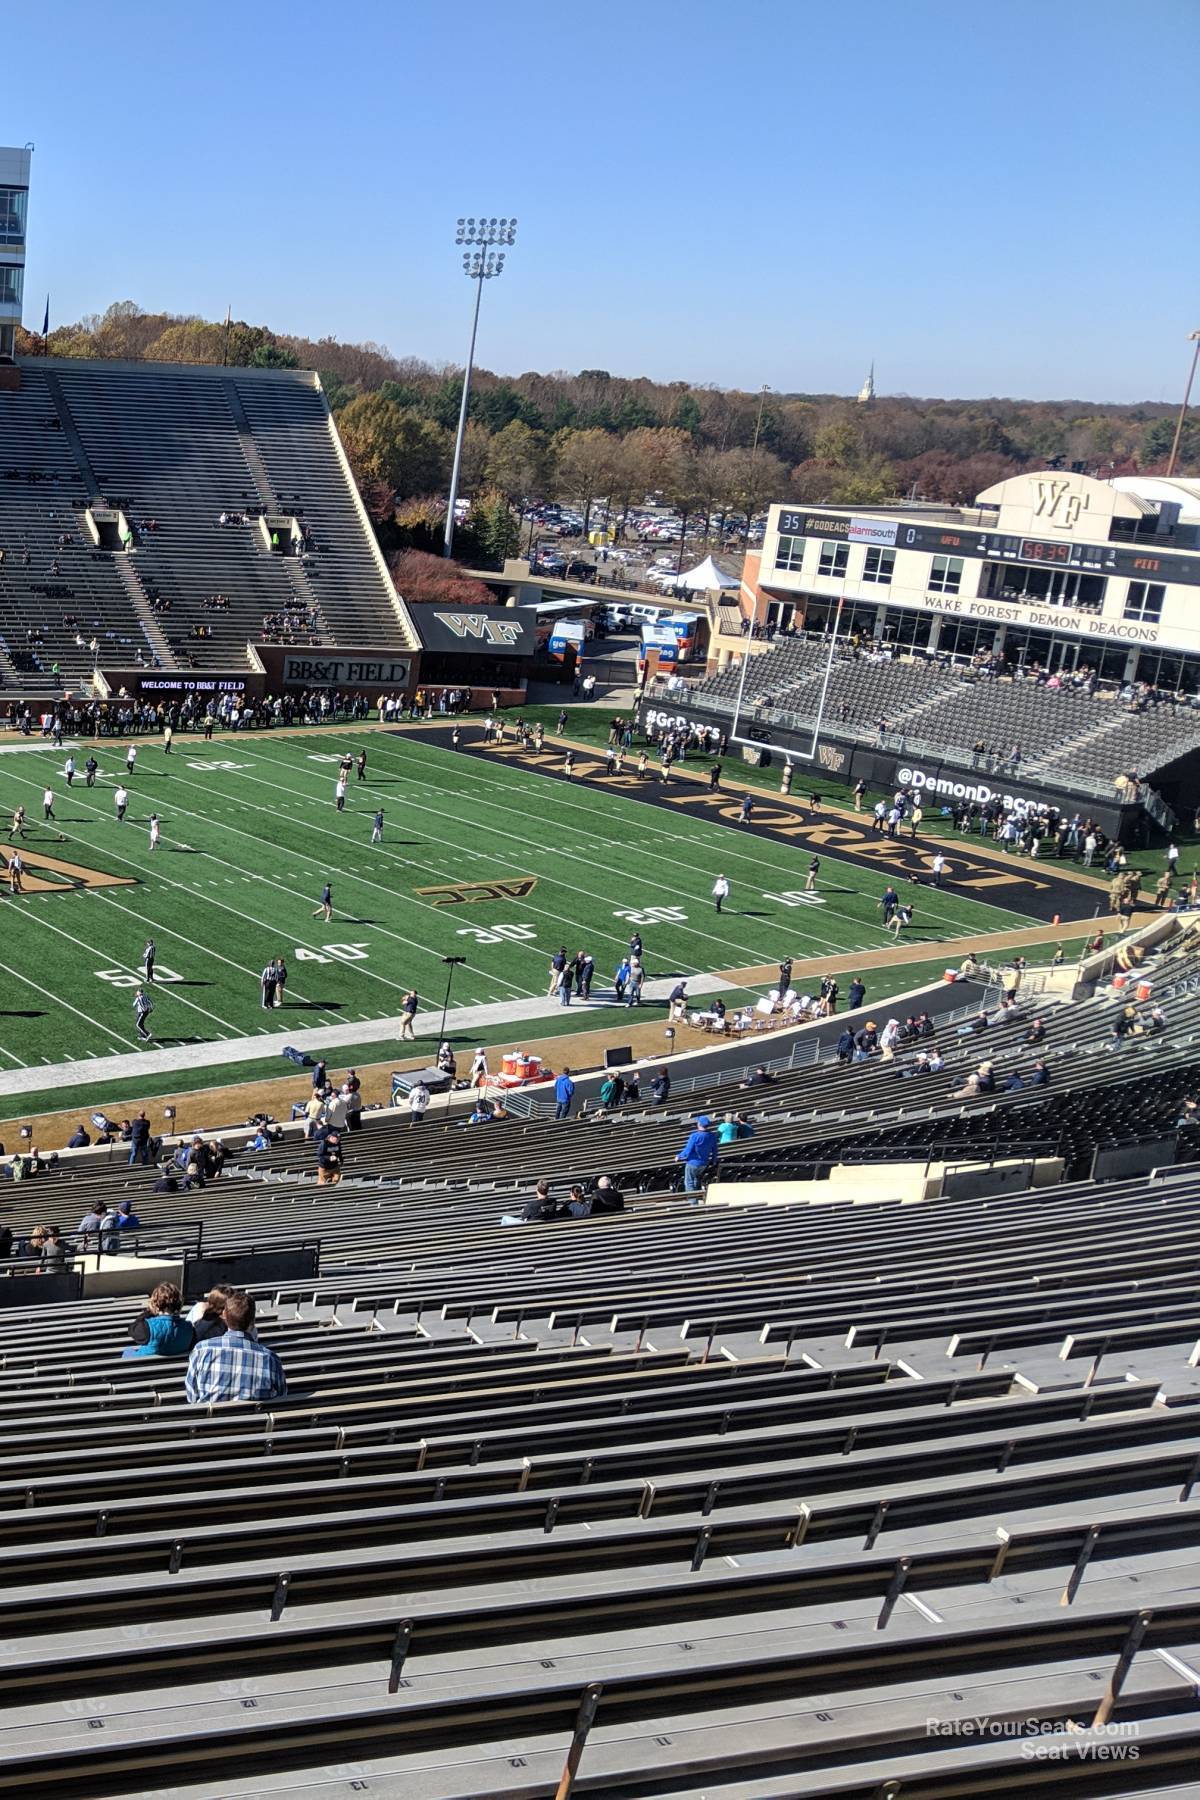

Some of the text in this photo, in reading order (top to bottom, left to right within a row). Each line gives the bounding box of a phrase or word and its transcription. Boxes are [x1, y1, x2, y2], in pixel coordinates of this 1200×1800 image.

[1030, 478, 1090, 529] WF
[805, 516, 850, 534] #GODEACS
[849, 523, 896, 539] alarmsouth
[433, 612, 524, 645] WF
[924, 596, 1158, 642] WAKE FOREST DEMON DEACONS
[286, 659, 407, 683] BB&T FIELD
[141, 681, 245, 691] WELCOME TO BB&T FIELD
[818, 744, 845, 772] WF
[660, 793, 1053, 892] FOREST
[414, 876, 539, 906] ACC
[762, 890, 827, 906] 10
[612, 906, 689, 925] 20
[456, 924, 538, 944] 30
[294, 943, 370, 963] 40
[93, 964, 185, 987] 50
